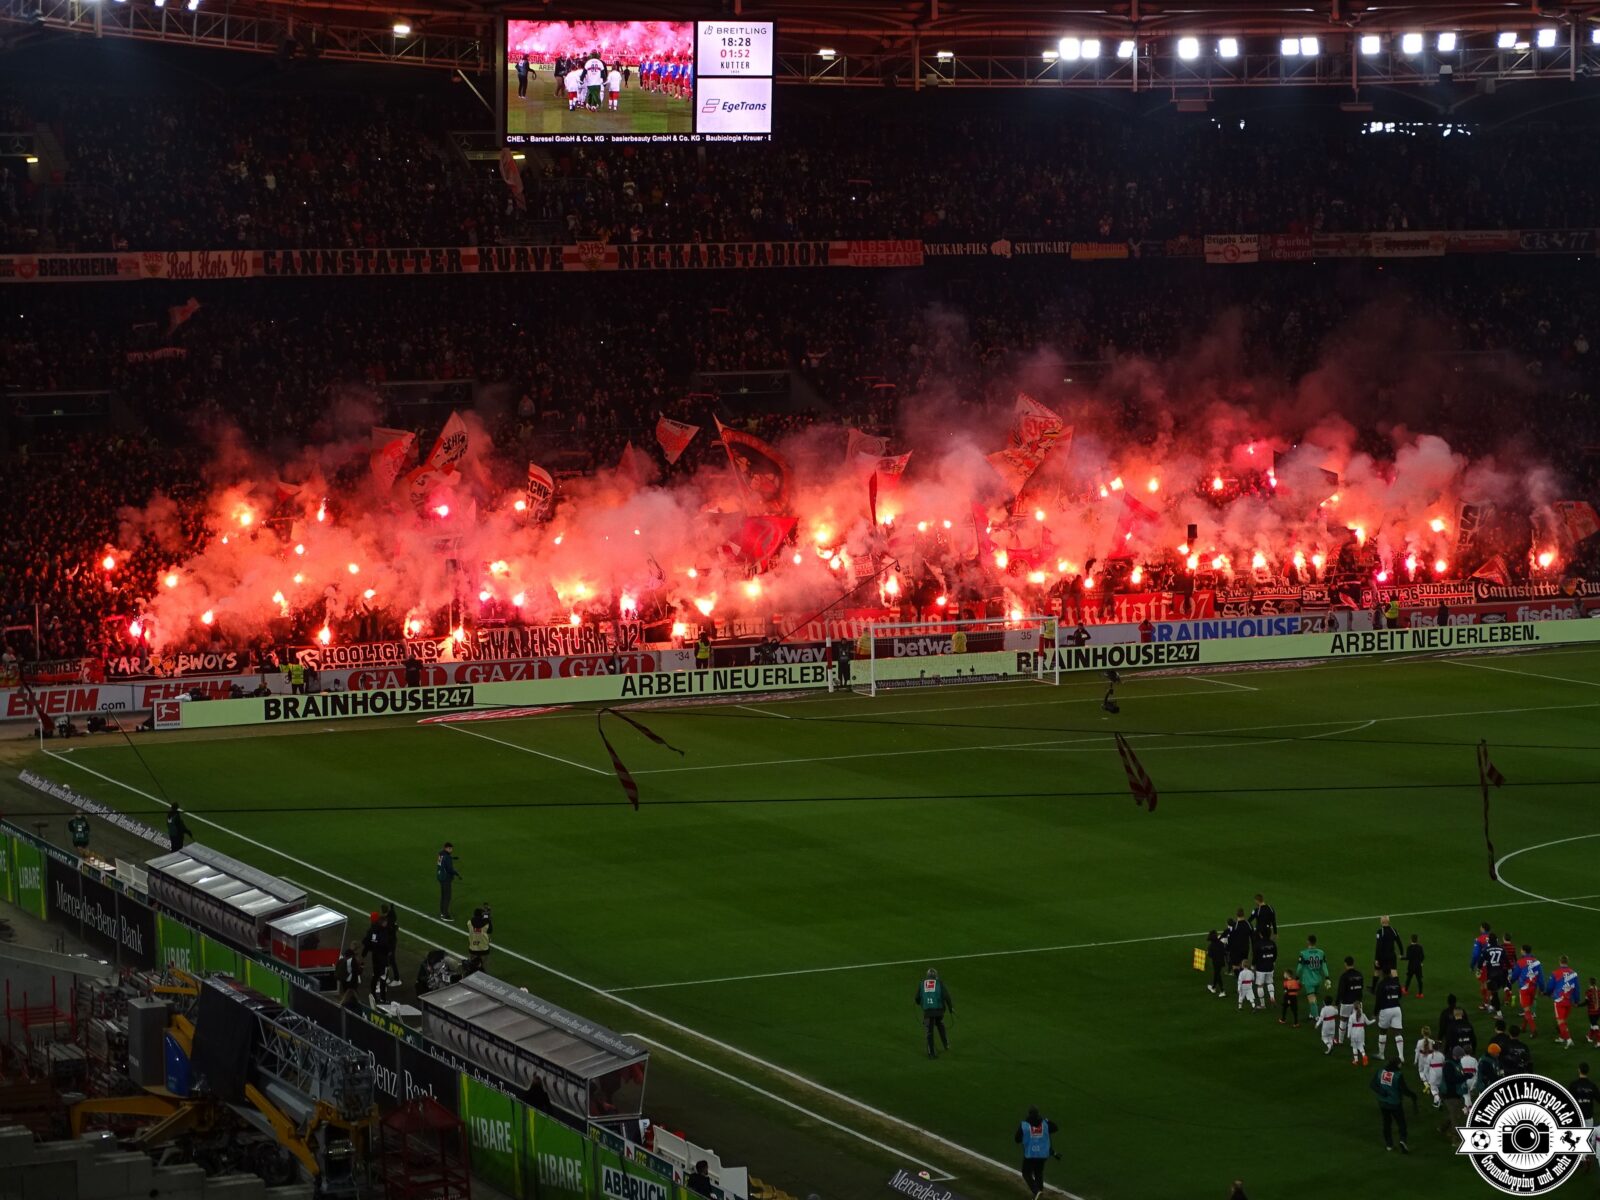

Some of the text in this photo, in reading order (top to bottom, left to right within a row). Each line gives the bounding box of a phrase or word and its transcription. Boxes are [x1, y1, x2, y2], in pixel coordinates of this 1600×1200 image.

[716, 27, 768, 35] BREITLING
[722, 37, 751, 47] 18:28
[720, 49, 750, 58] 01:52
[720, 61, 750, 69] KUTTER
[722, 102, 767, 112] EgeTrans
[850, 240, 921, 252] ALBSTADT
[924, 242, 989, 256] NECKAR-FILS
[1014, 241, 1071, 255] STUTTGART
[1569, 232, 1590, 250] 77
[167, 249, 248, 279] Red Hots 96
[263, 246, 563, 276] CANNSTATTER KURVE
[617, 242, 829, 270] NECKARSTADION
[853, 252, 921, 266] VFB-FANS
[38, 257, 118, 277] BERKHEIM
[1020, 632, 1031, 641] 35
[1330, 624, 1540, 654] ARBEIT NEU ERLEBEN.
[322, 641, 437, 664] HOOLIGANS
[620, 671, 709, 697] ARBEIT
[713, 667, 759, 691] NEU
[7, 687, 125, 717] EHEIM .com
[19, 866, 40, 889] LIBARE
[56, 879, 117, 941] Mercedes-Benz
[121, 914, 144, 957] Bank
[1489, 951, 1502, 964] 27
[470, 1116, 513, 1153] LIBARE
[537, 1152, 584, 1193] LIBARE
[604, 1169, 667, 1200] ABBRUCH
